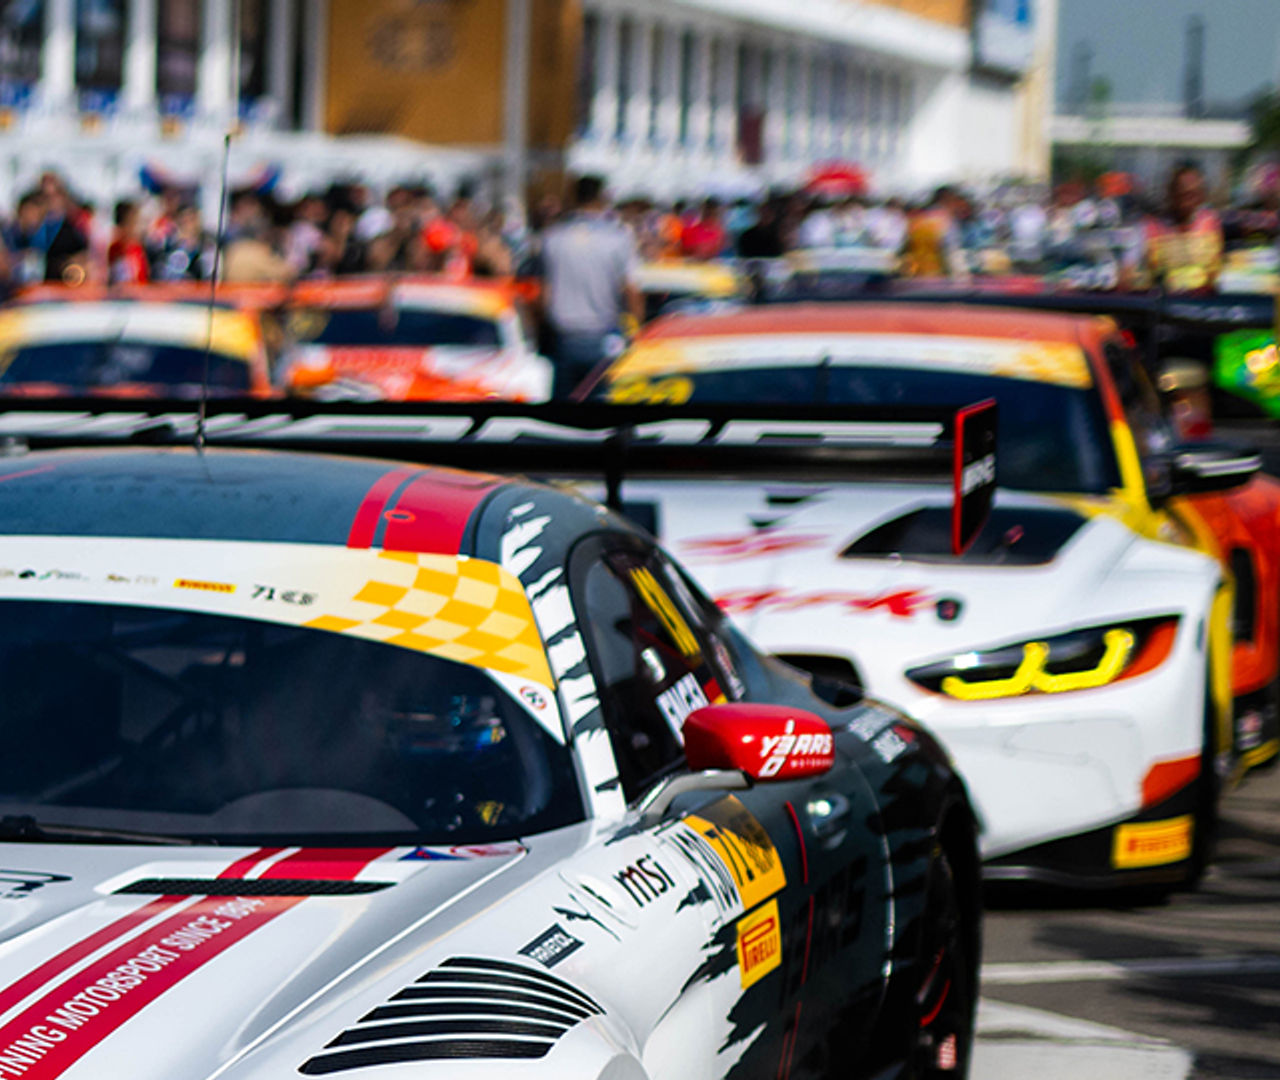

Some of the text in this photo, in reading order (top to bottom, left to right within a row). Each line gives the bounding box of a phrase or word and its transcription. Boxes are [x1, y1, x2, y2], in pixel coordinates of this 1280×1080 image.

[612, 852, 676, 909] msi
[46, 945, 181, 1031] MOTORSPORT
[161, 915, 233, 951] SINCE
[740, 916, 776, 974] PIRELLI
